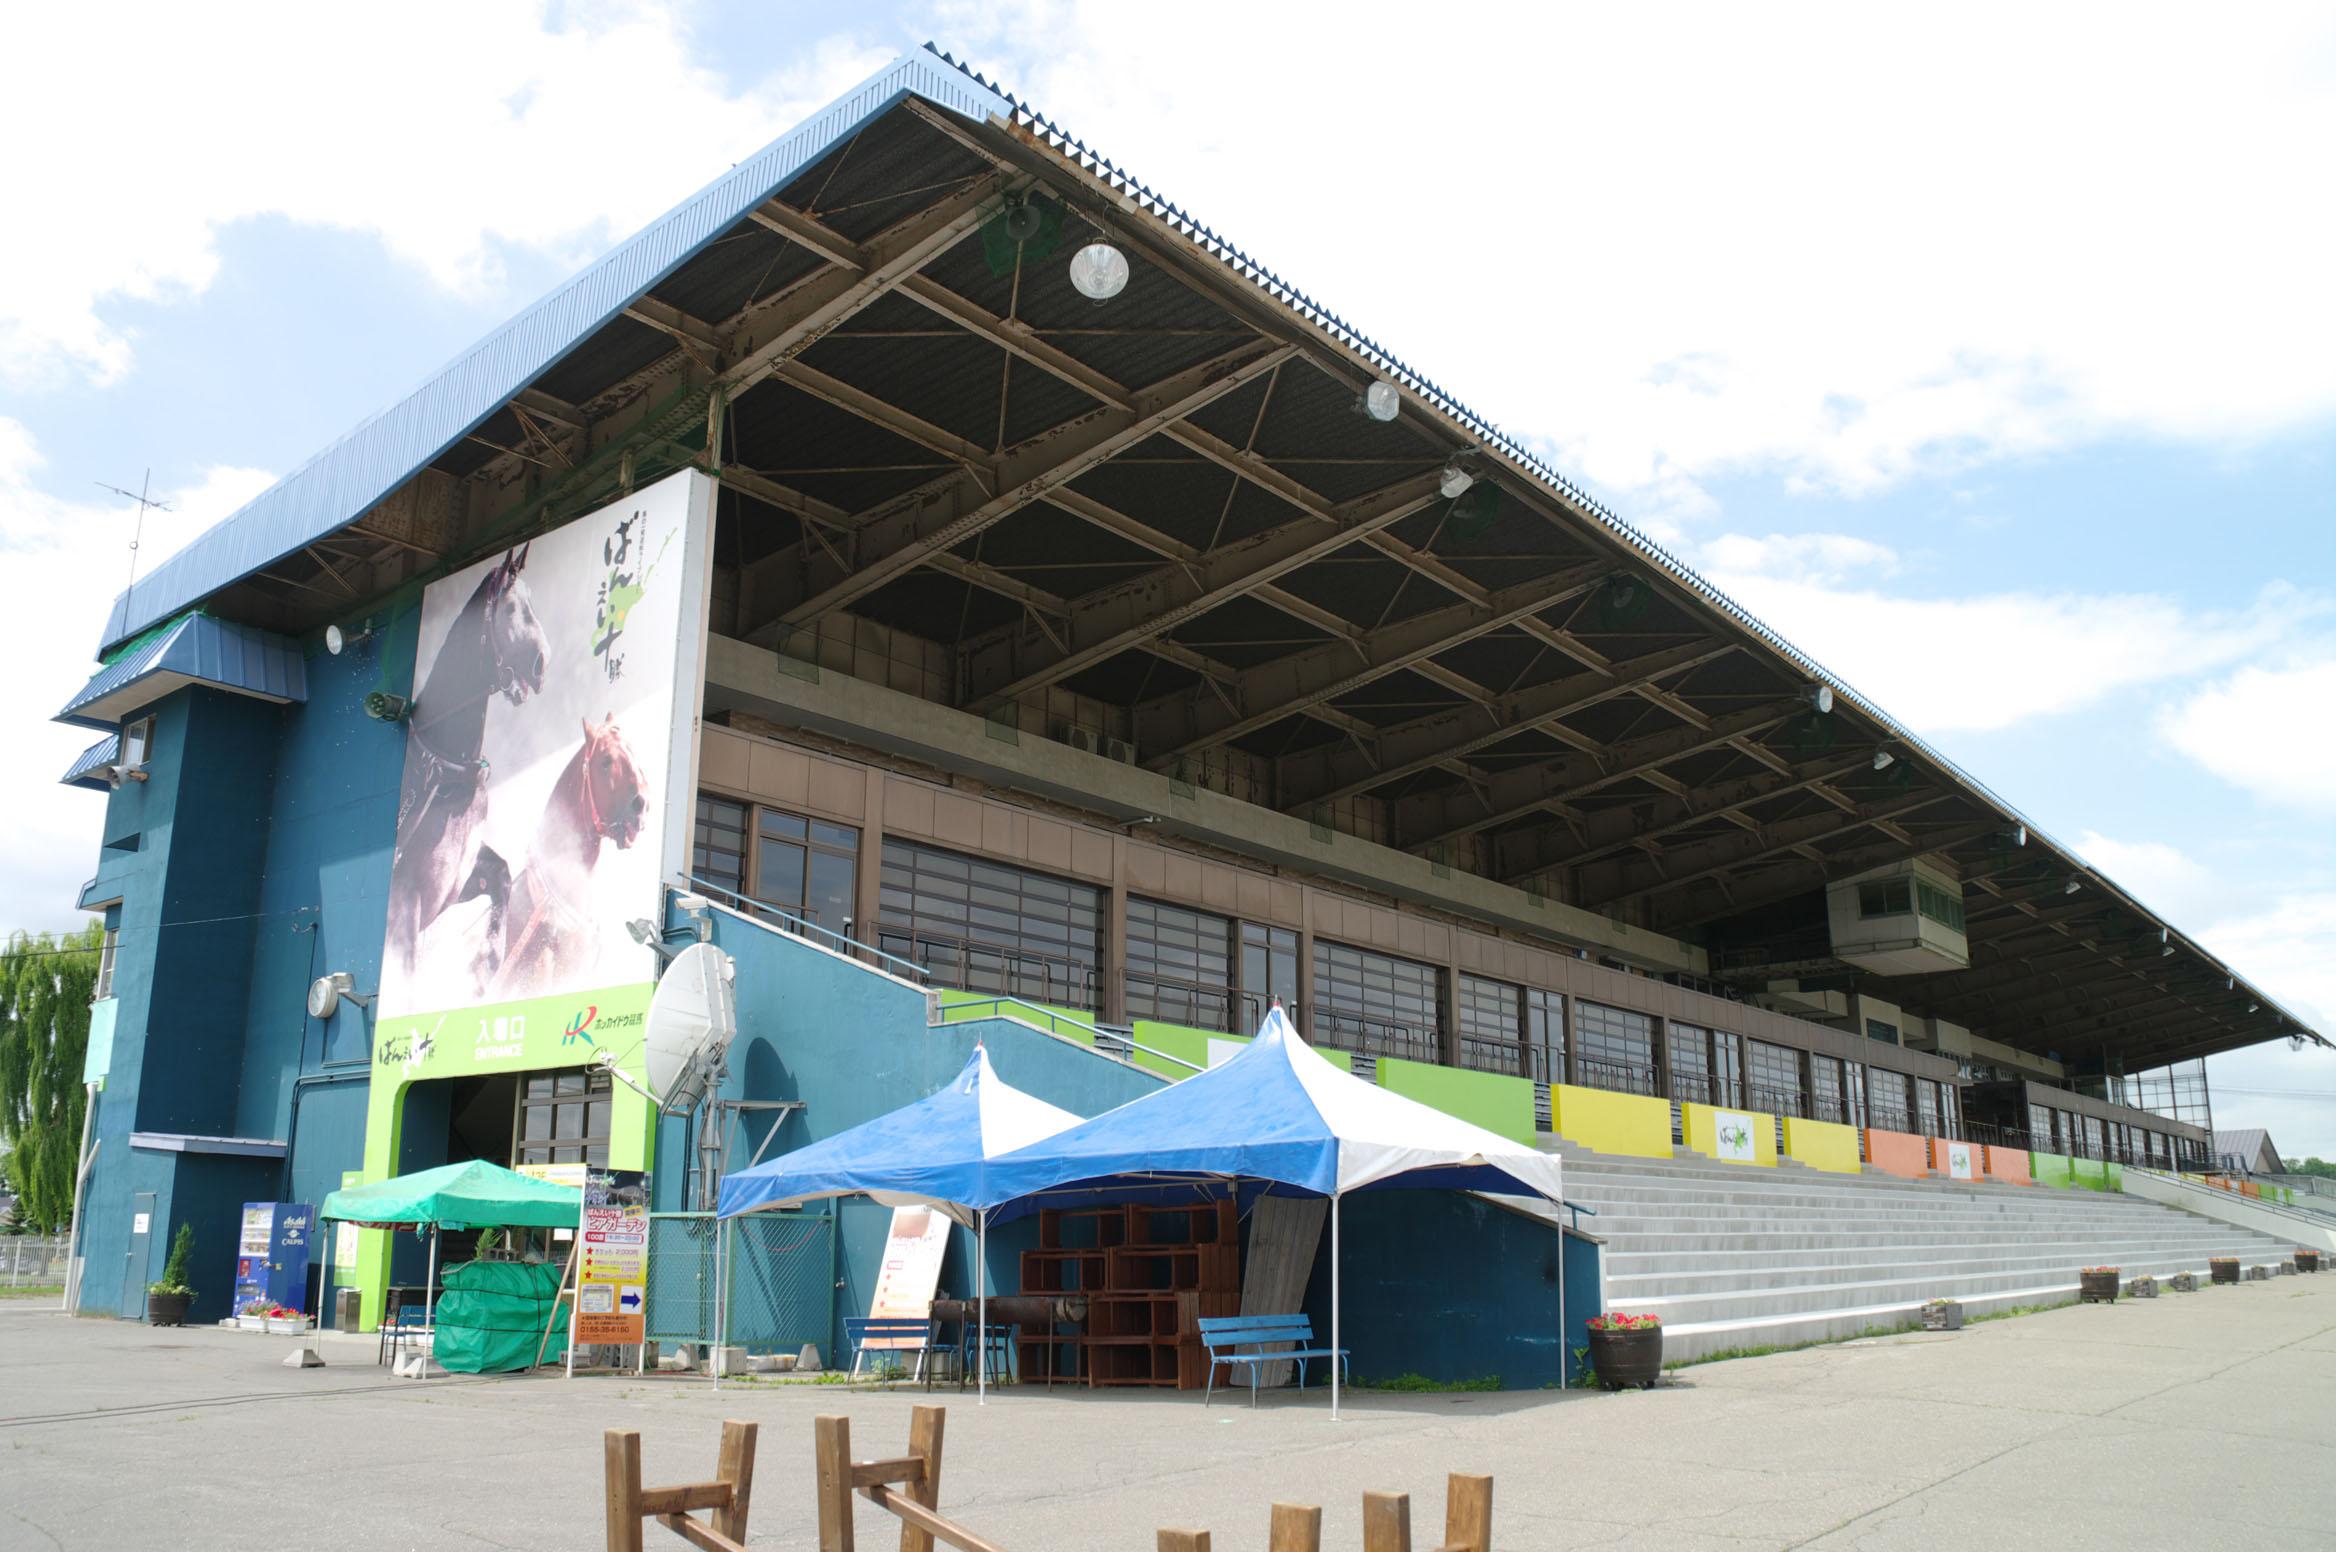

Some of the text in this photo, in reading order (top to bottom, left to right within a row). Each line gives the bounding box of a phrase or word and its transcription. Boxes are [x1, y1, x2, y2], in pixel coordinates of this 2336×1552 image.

[587, 1217, 647, 1232] ビアガーデン
[281, 1238, 304, 1246] CALPIS
